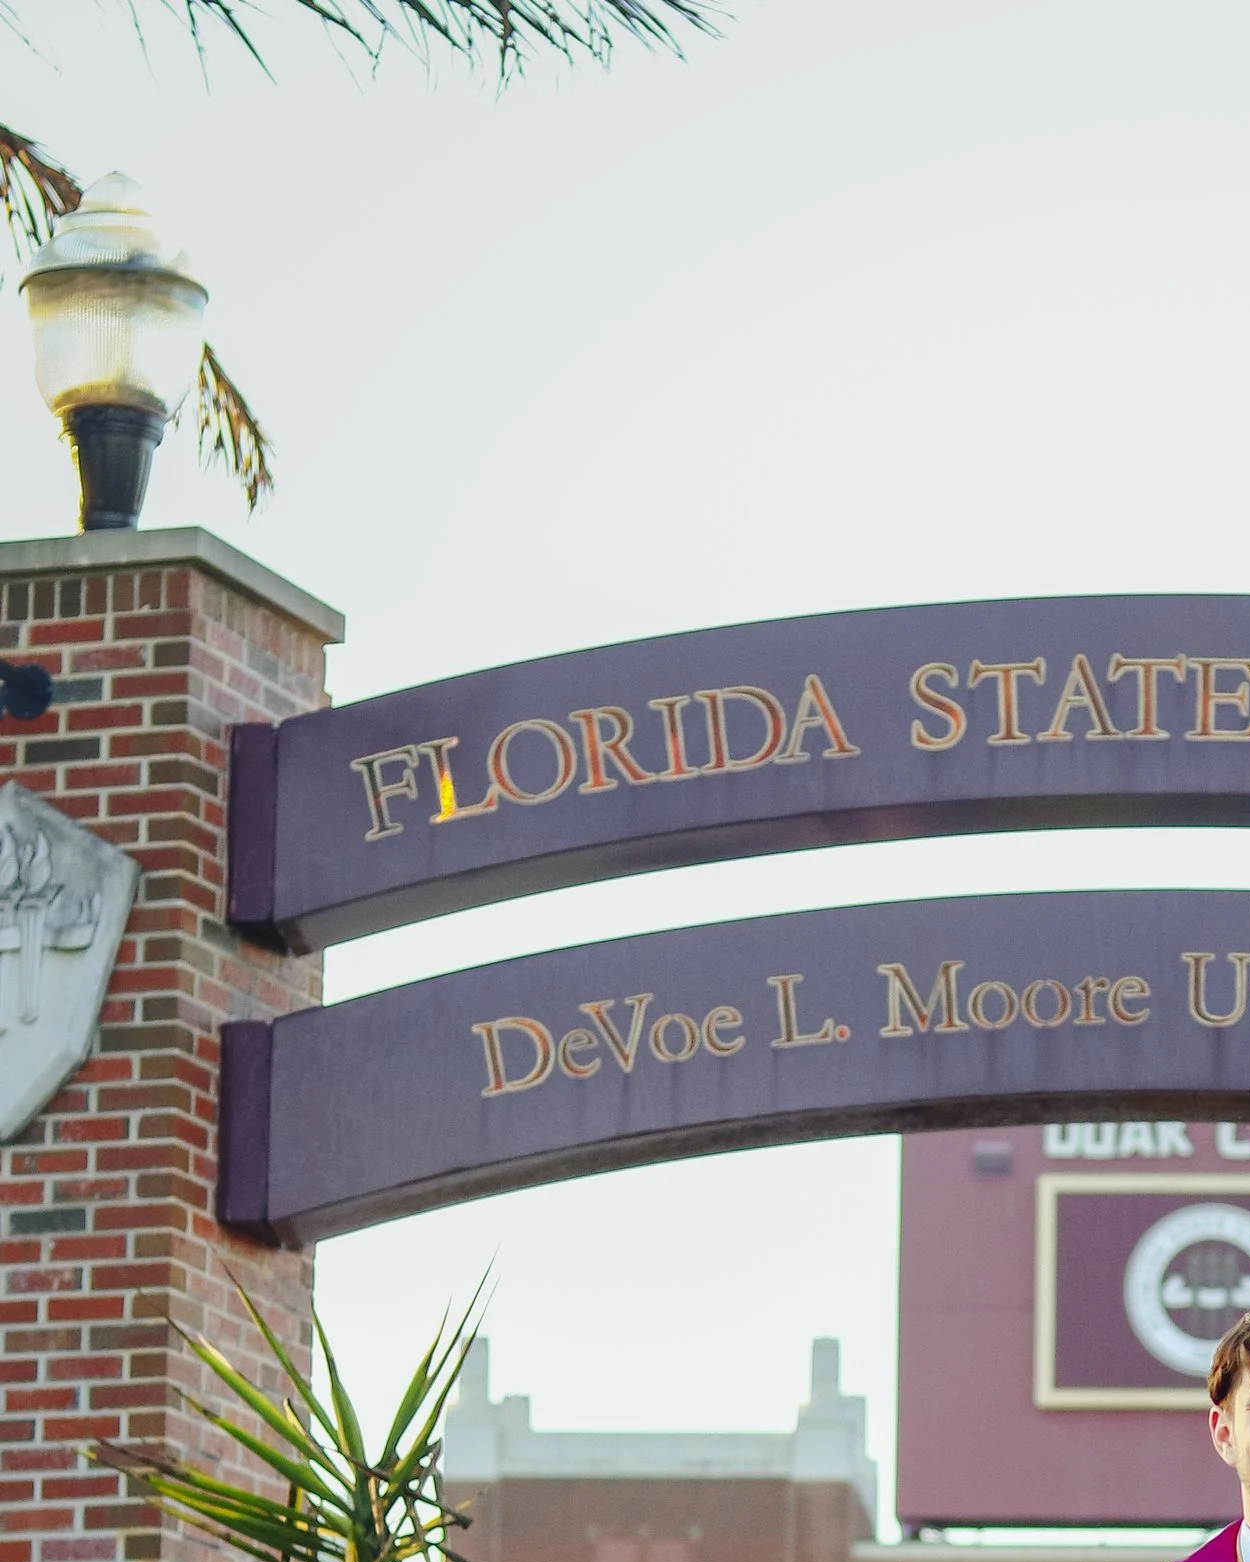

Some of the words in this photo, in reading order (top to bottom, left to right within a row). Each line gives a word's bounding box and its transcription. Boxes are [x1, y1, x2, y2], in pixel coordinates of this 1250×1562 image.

[350, 673, 859, 841] FLORIDA
[471, 993, 746, 1098] DeVoe
[768, 973, 851, 1048] L.
[877, 960, 1151, 1038] Moore
